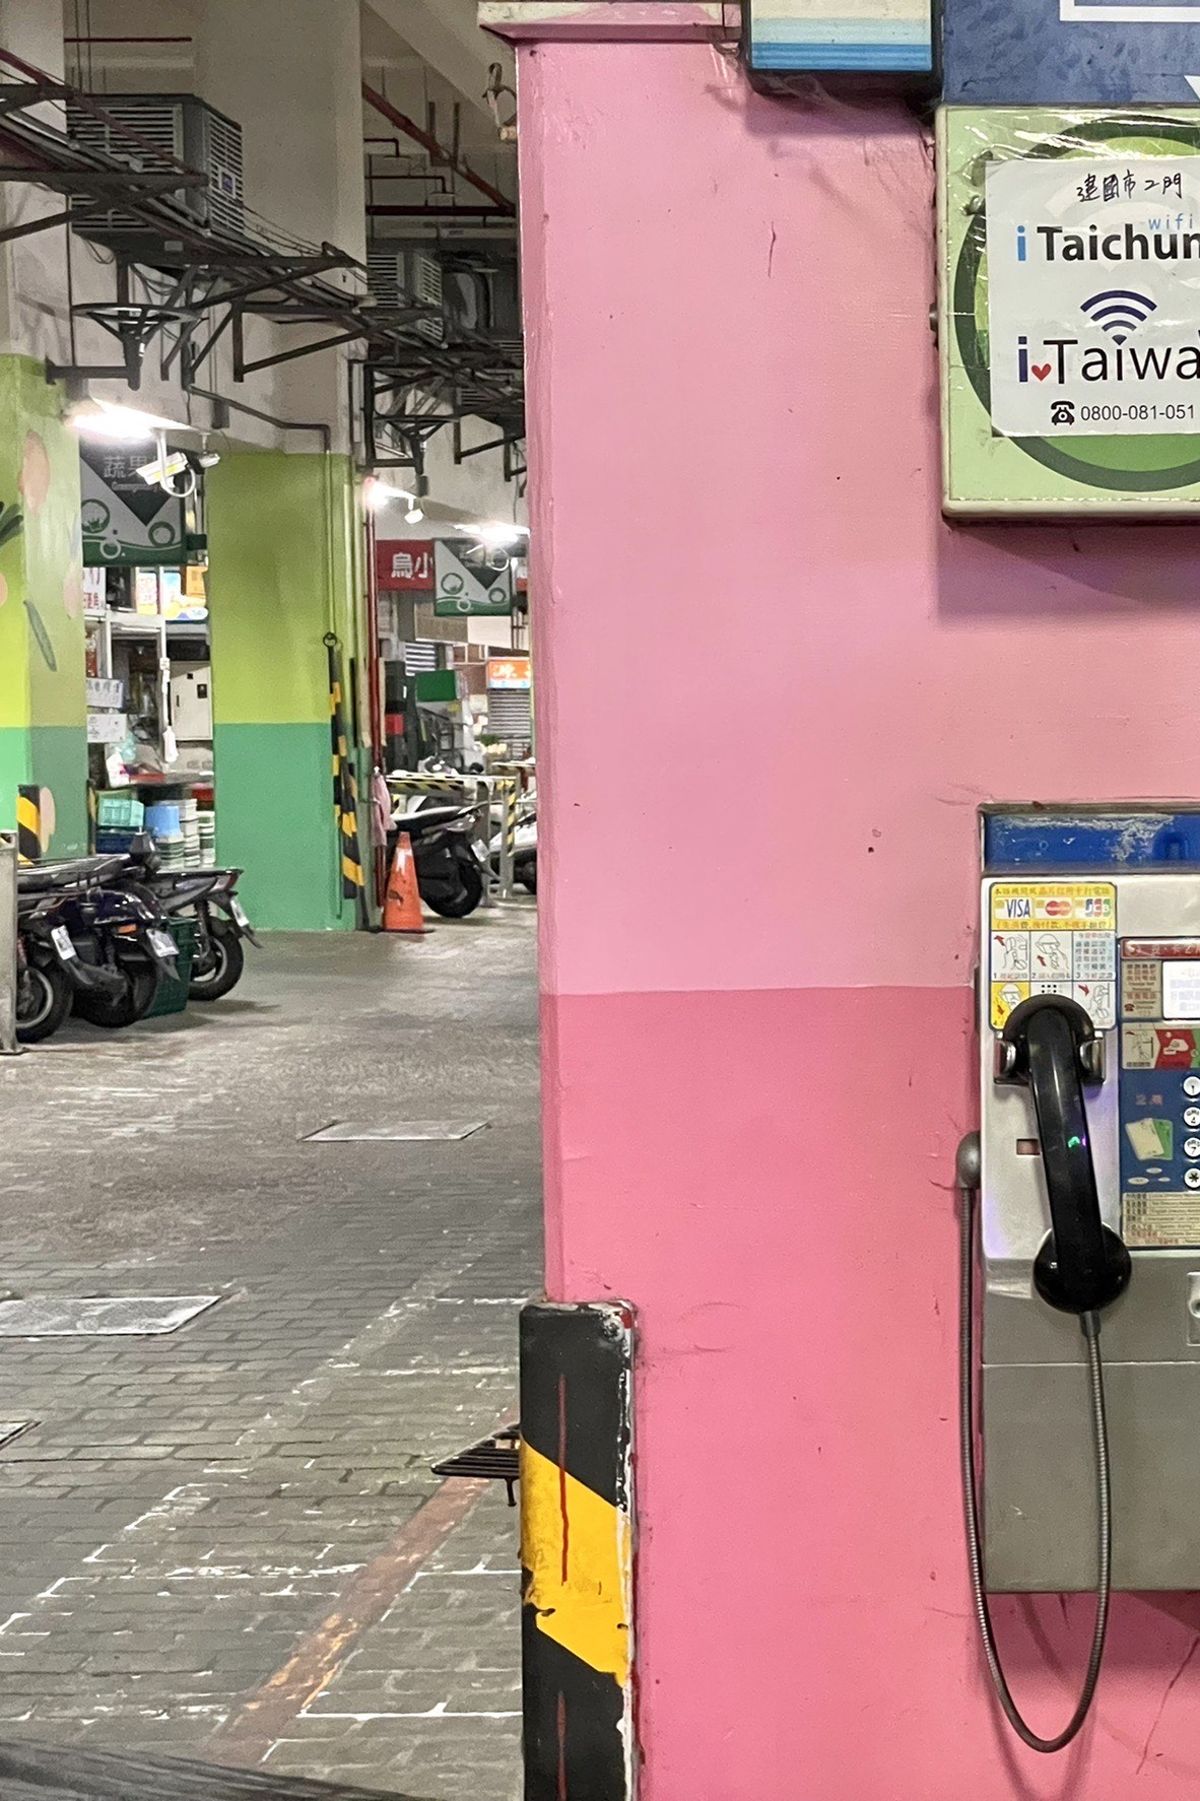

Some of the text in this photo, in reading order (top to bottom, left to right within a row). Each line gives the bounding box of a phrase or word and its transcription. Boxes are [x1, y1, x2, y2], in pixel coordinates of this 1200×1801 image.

[1148, 213, 1194, 231] wifi
[1016, 225, 1027, 263] i
[1080, 404, 1195, 421] 0800-081-051
[1006, 899, 1031, 918] VISA
